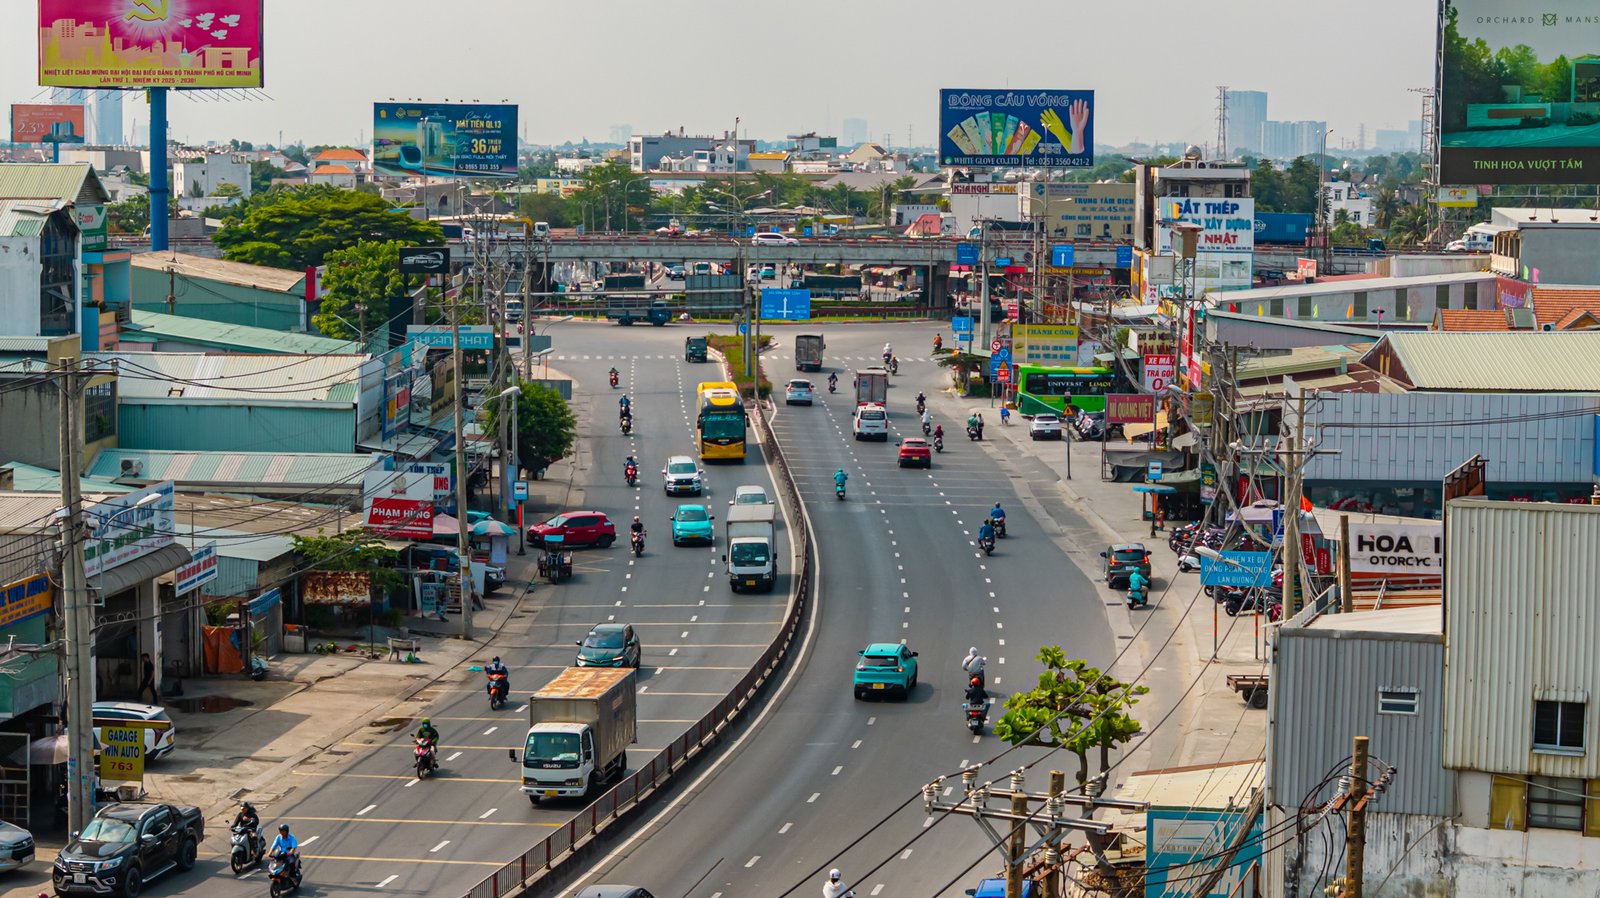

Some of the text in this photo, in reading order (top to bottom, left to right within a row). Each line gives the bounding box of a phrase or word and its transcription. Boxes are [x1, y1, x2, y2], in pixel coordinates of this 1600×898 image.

[1476, 16, 1534, 24] ORCHARD
[471, 138, 487, 154] 36
[953, 157, 975, 165] WHITE
[975, 157, 995, 165] GLOVE
[1473, 160, 1498, 169] TINH
[1501, 160, 1525, 169] HOA
[1204, 200, 1240, 215] THÉP
[1204, 216, 1223, 230] XÂY
[1225, 217, 1252, 232] DỰNG
[1204, 231, 1238, 246] NHẬT
[1148, 357, 1158, 365] XE
[372, 507, 401, 519] PHẠM
[107, 729, 138, 743] GARAGE
[105, 744, 140, 759] WIN AUTO
[110, 761, 133, 771] 763
